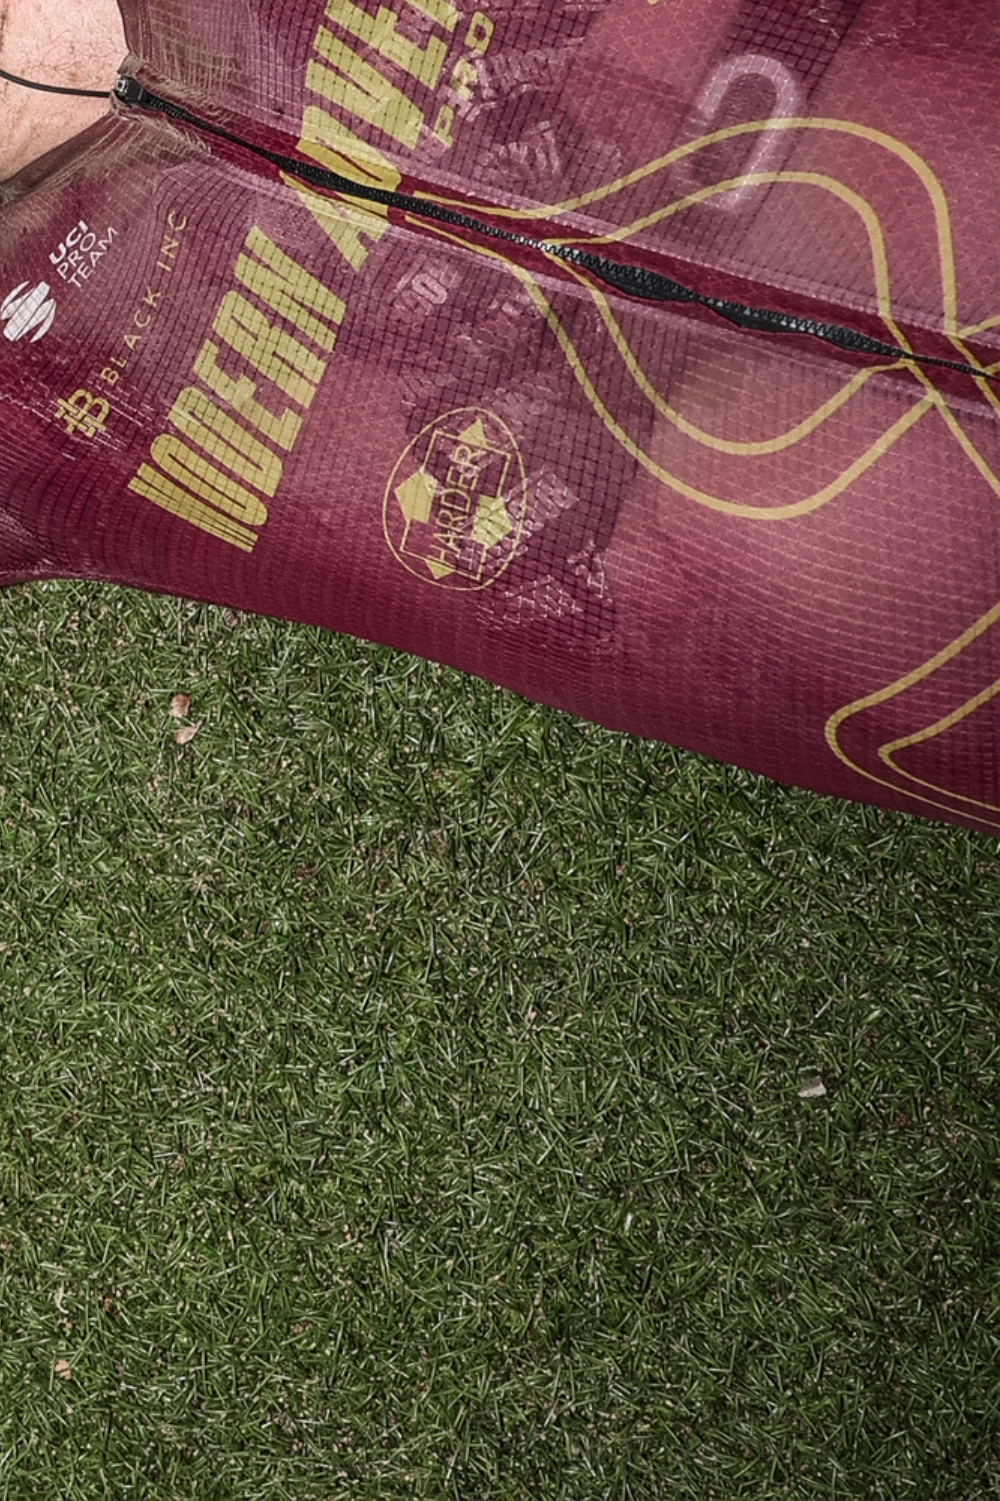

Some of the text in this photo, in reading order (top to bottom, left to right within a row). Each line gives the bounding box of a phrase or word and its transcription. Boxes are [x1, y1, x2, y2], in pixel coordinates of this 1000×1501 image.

[434, 12, 491, 147] PRO
[49, 221, 89, 265] UCI
[57, 232, 97, 279] PRO
[69, 227, 118, 288] TEAM
[101, 288, 160, 385] BLACK
[157, 212, 188, 272] INC
[127, 225, 347, 552] MODERN
[430, 444, 486, 563] HARDER
